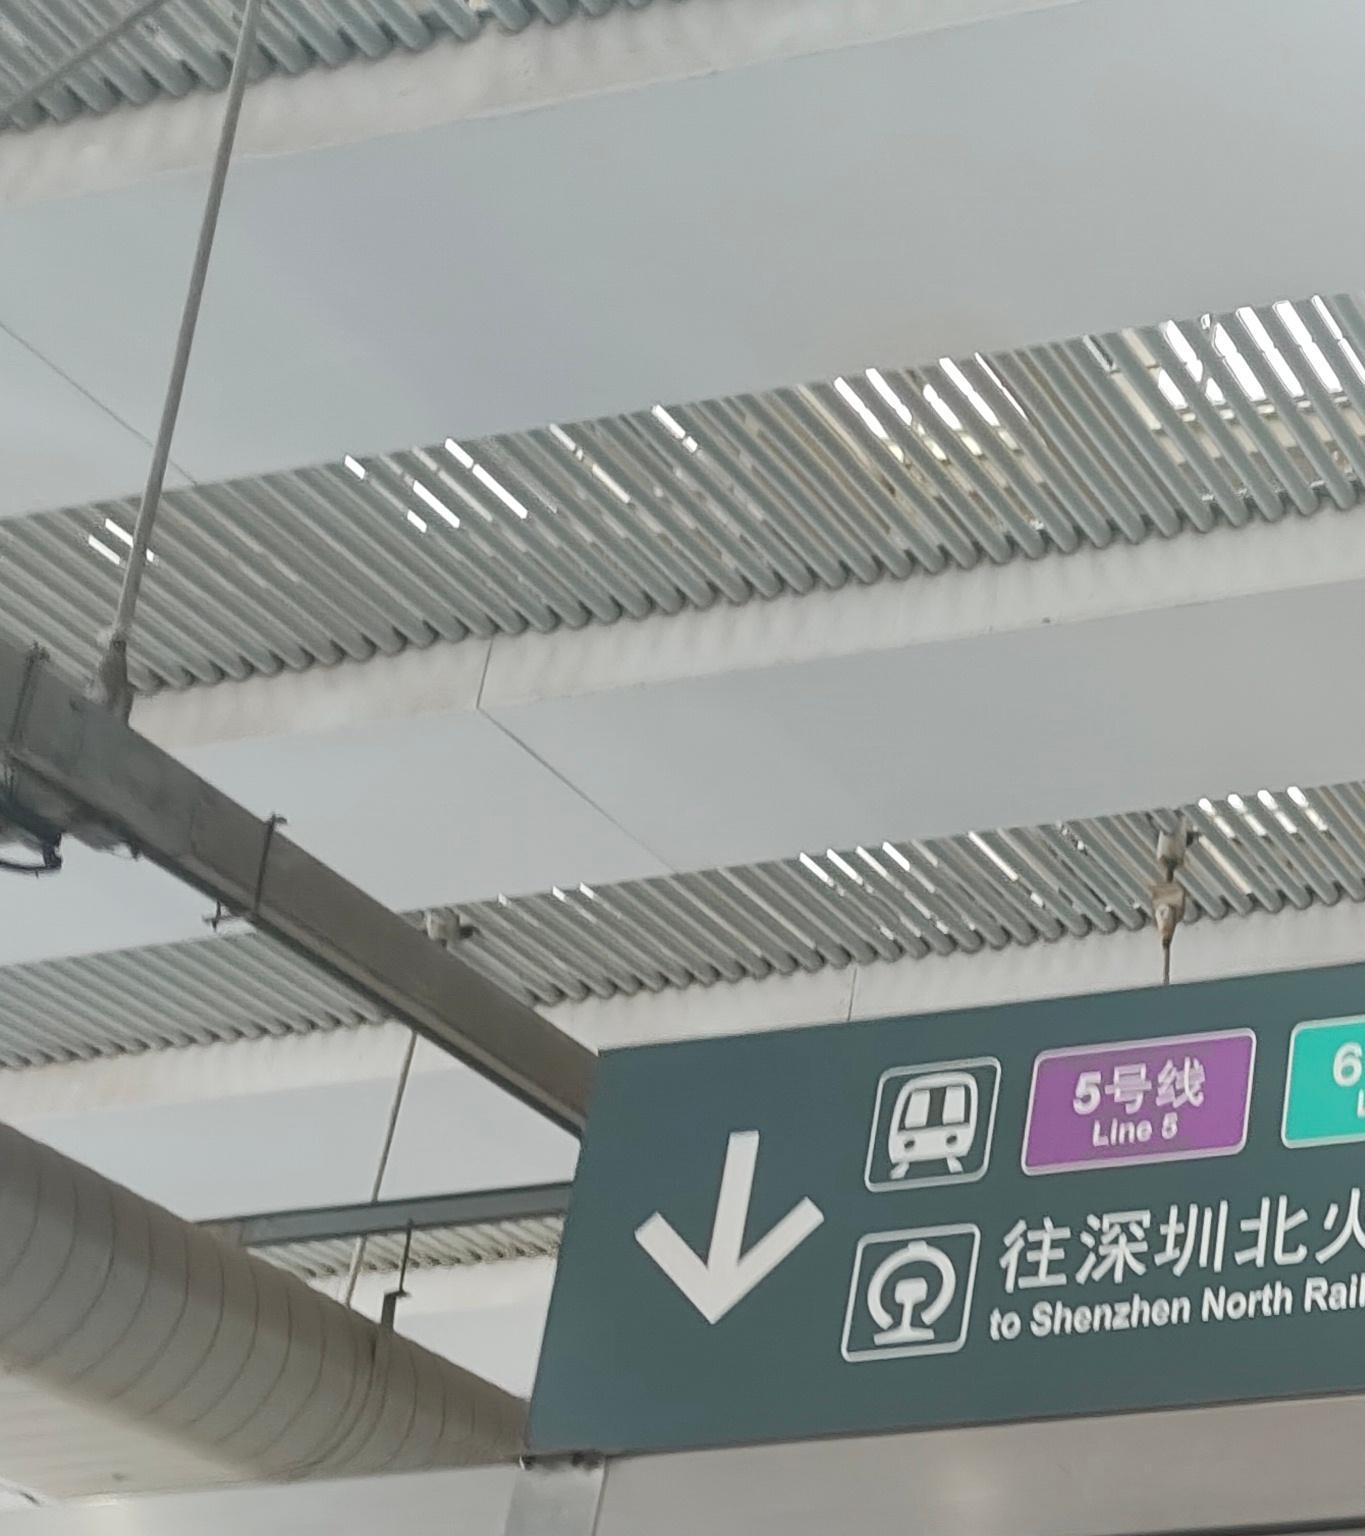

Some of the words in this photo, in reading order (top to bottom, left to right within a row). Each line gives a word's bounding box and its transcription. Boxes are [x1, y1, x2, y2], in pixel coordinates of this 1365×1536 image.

[1072, 1056, 1206, 1115] 5号线
[1092, 1115, 1153, 1147] Line
[1160, 1112, 1179, 1140] 5
[989, 1307, 1022, 1341] to
[1029, 1292, 1192, 1338] Shenzhen
[1200, 1279, 1295, 1322] North
